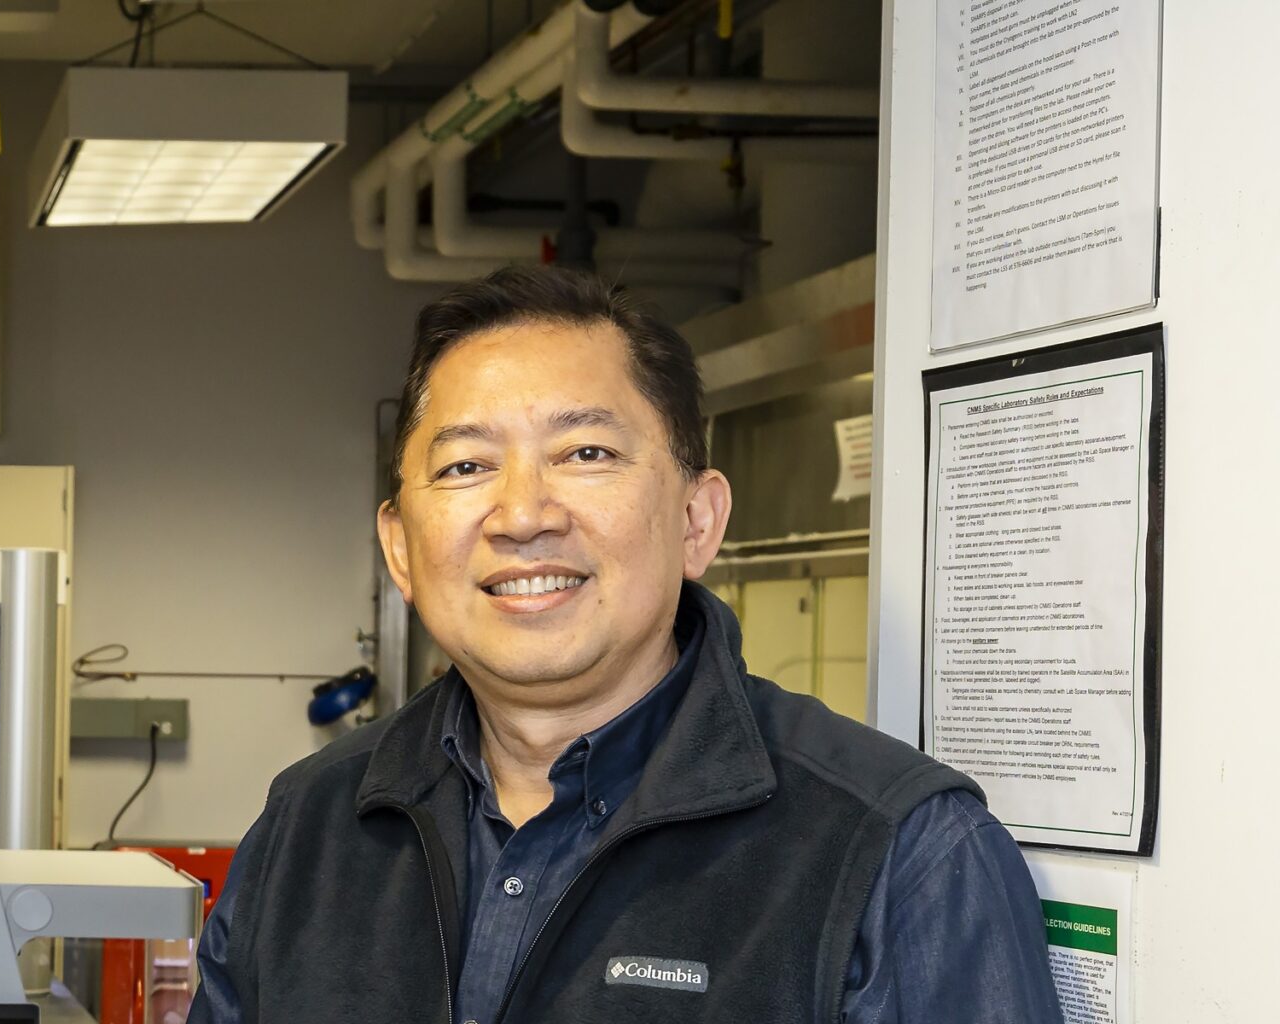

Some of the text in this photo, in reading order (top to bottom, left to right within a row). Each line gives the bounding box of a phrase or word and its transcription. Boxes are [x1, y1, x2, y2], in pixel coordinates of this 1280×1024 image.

[967, 405, 982, 413] CNMS
[982, 402, 1000, 412] Specific
[1001, 399, 1028, 408] Laboratory
[1059, 391, 1069, 399] and
[1070, 387, 1104, 398] Expectations
[1073, 922, 1111, 936] GUIDELINES
[625, 962, 702, 984] Columbia
